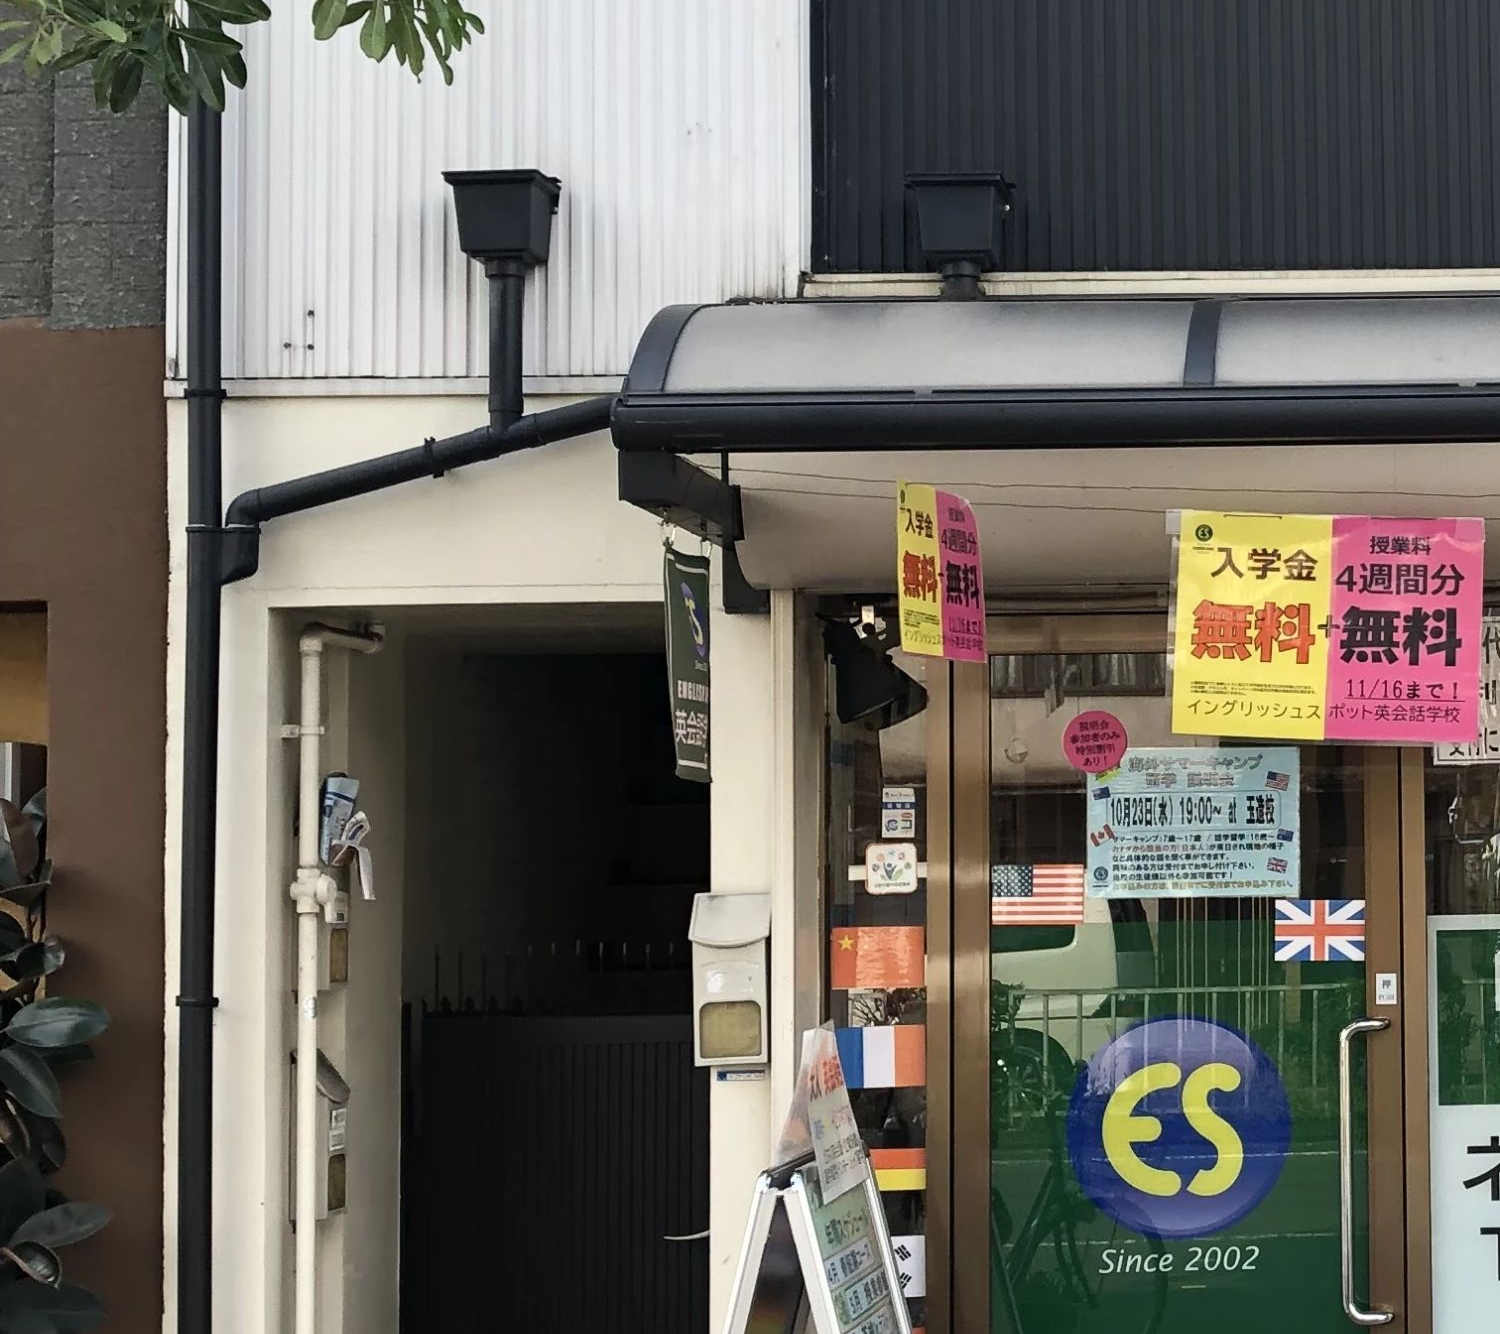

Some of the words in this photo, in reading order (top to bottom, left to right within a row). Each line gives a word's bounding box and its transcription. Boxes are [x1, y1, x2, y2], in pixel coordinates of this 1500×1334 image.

[905, 509, 934, 539] 入学金
[1369, 535, 1431, 556] 授業料
[903, 550, 938, 603] 無料
[946, 561, 980, 609] 無料
[1211, 548, 1318, 582] 入学金
[1335, 563, 1465, 596] 4週間分
[1190, 599, 1316, 665] 無料
[1340, 605, 1462, 667] 無料
[1102, 1062, 1243, 1196] ES
[1099, 1248, 1174, 1274] Since
[1184, 1245, 1260, 1271] 2002
